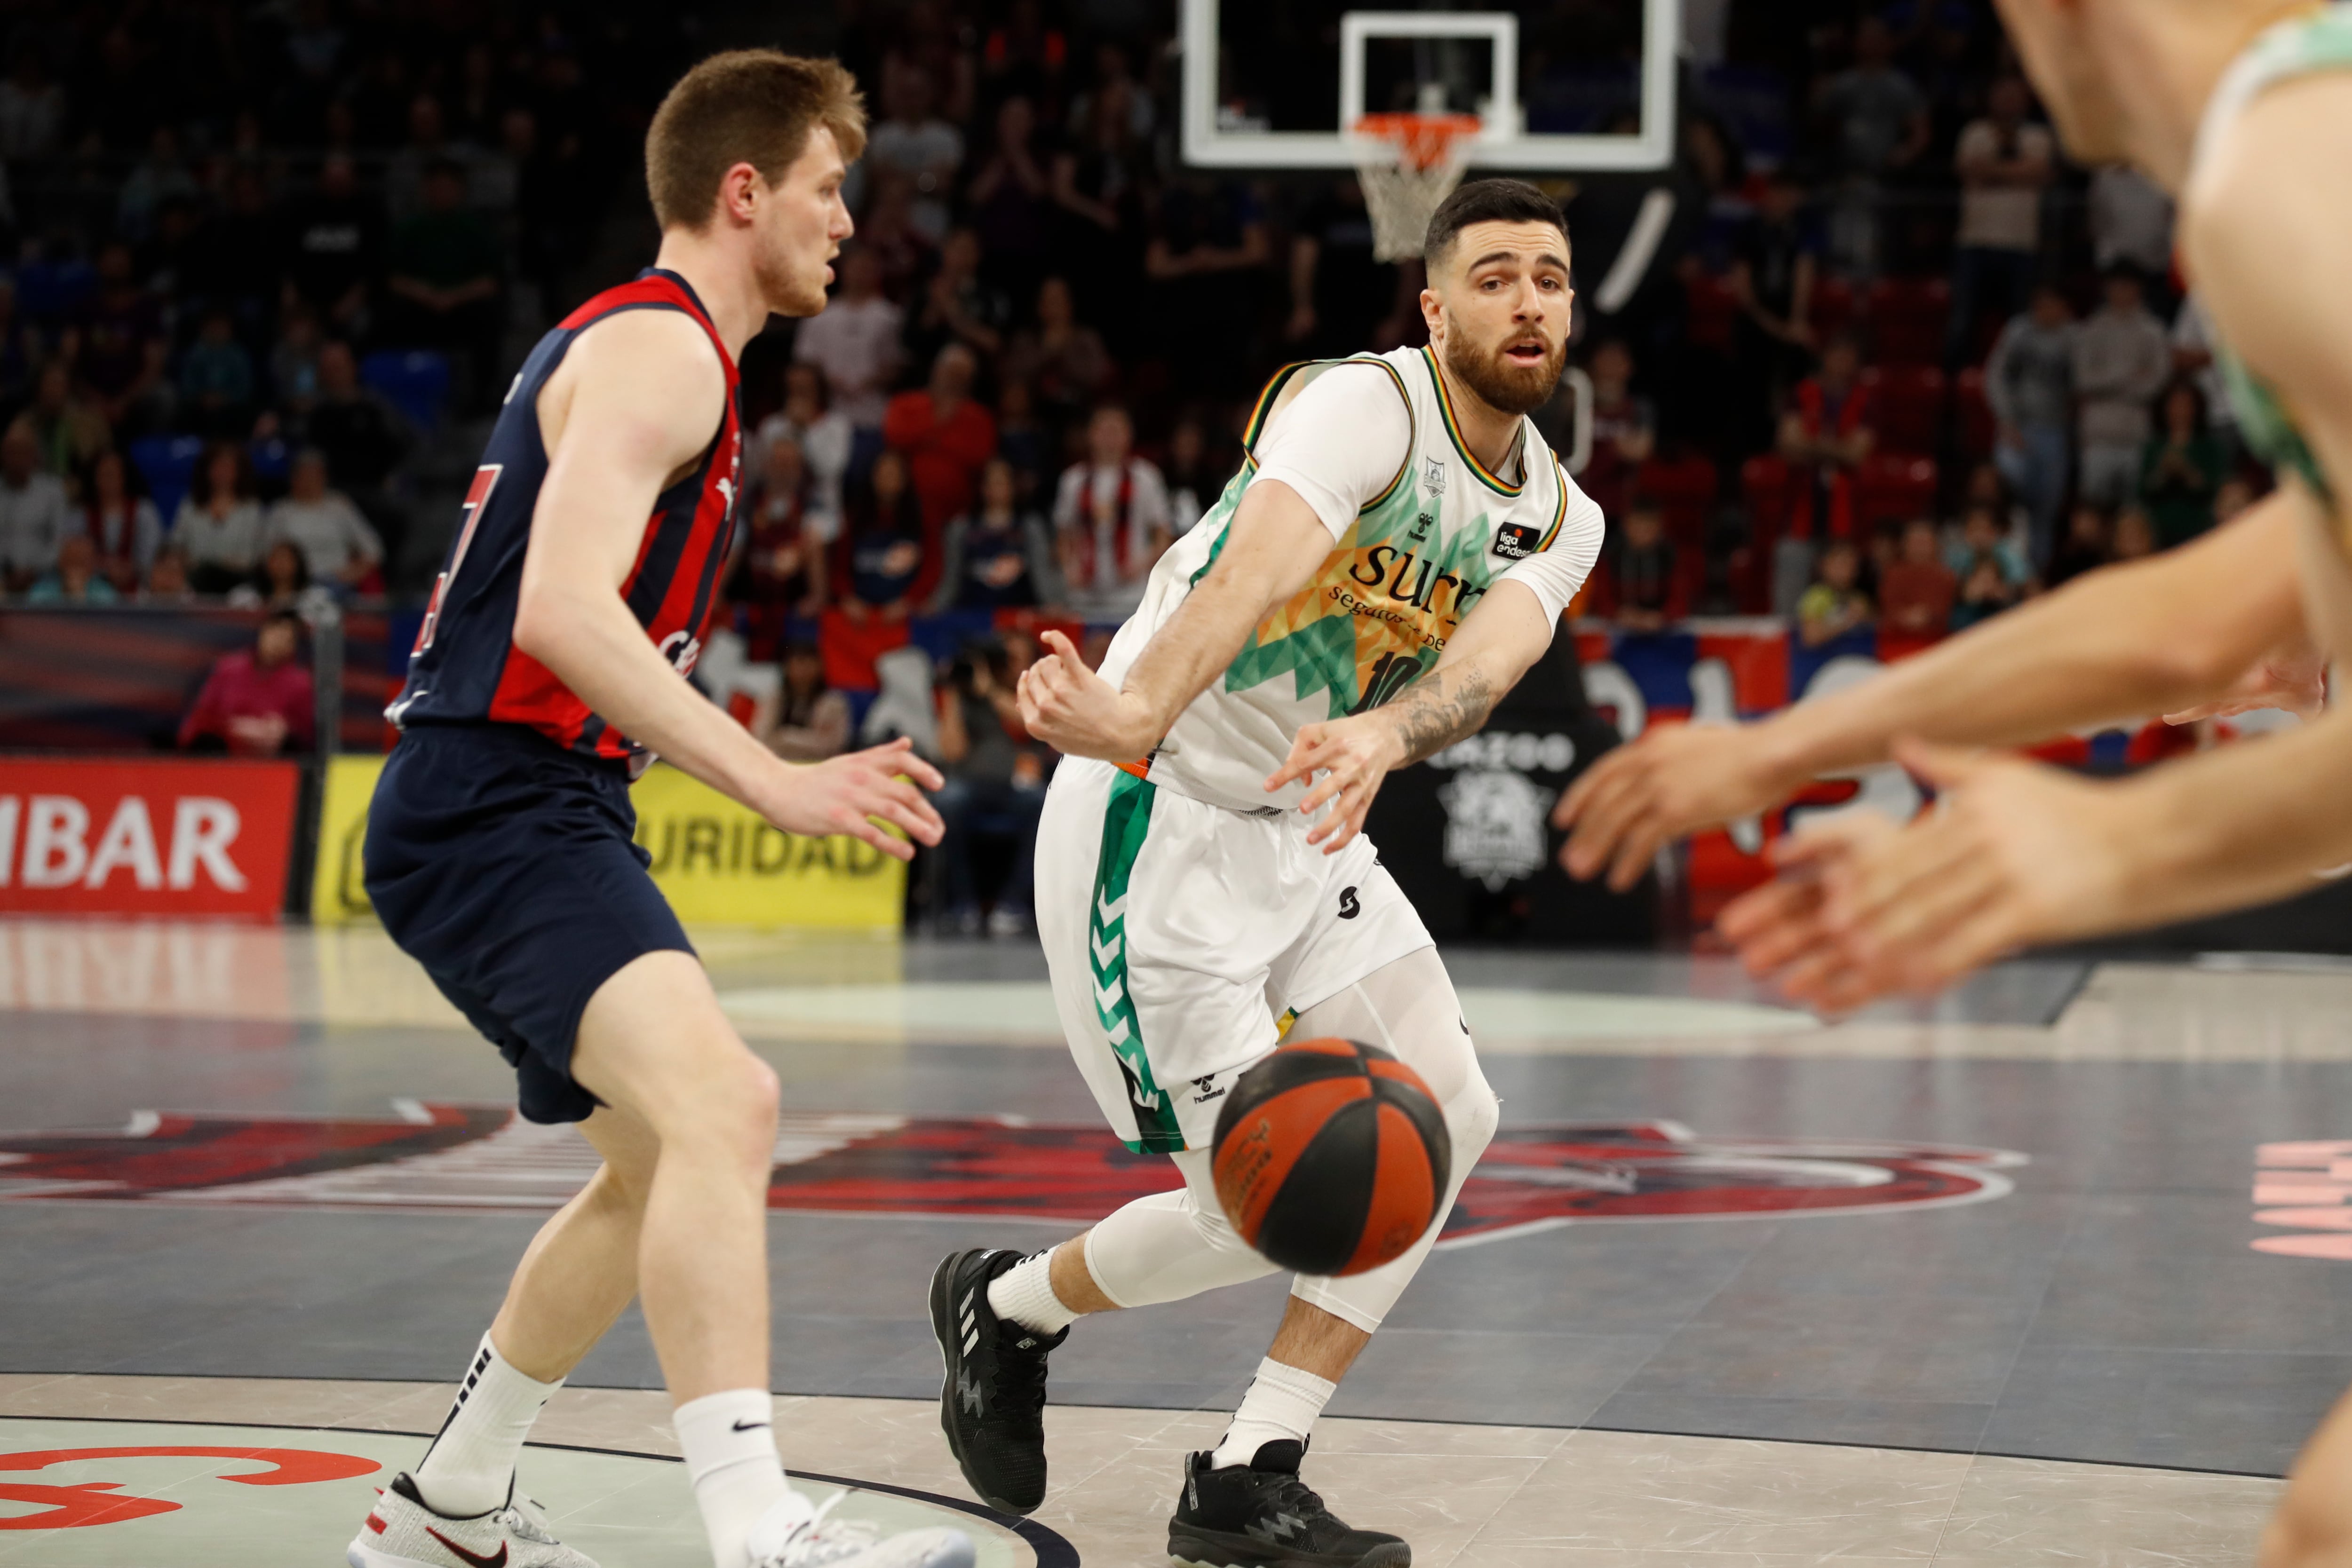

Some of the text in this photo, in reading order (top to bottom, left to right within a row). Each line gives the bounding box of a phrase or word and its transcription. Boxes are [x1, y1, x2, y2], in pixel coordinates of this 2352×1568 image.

[1500, 531, 1519, 546] liga
[0, 793, 248, 893] BAR
[1193, 1086, 1225, 1104] hummel
